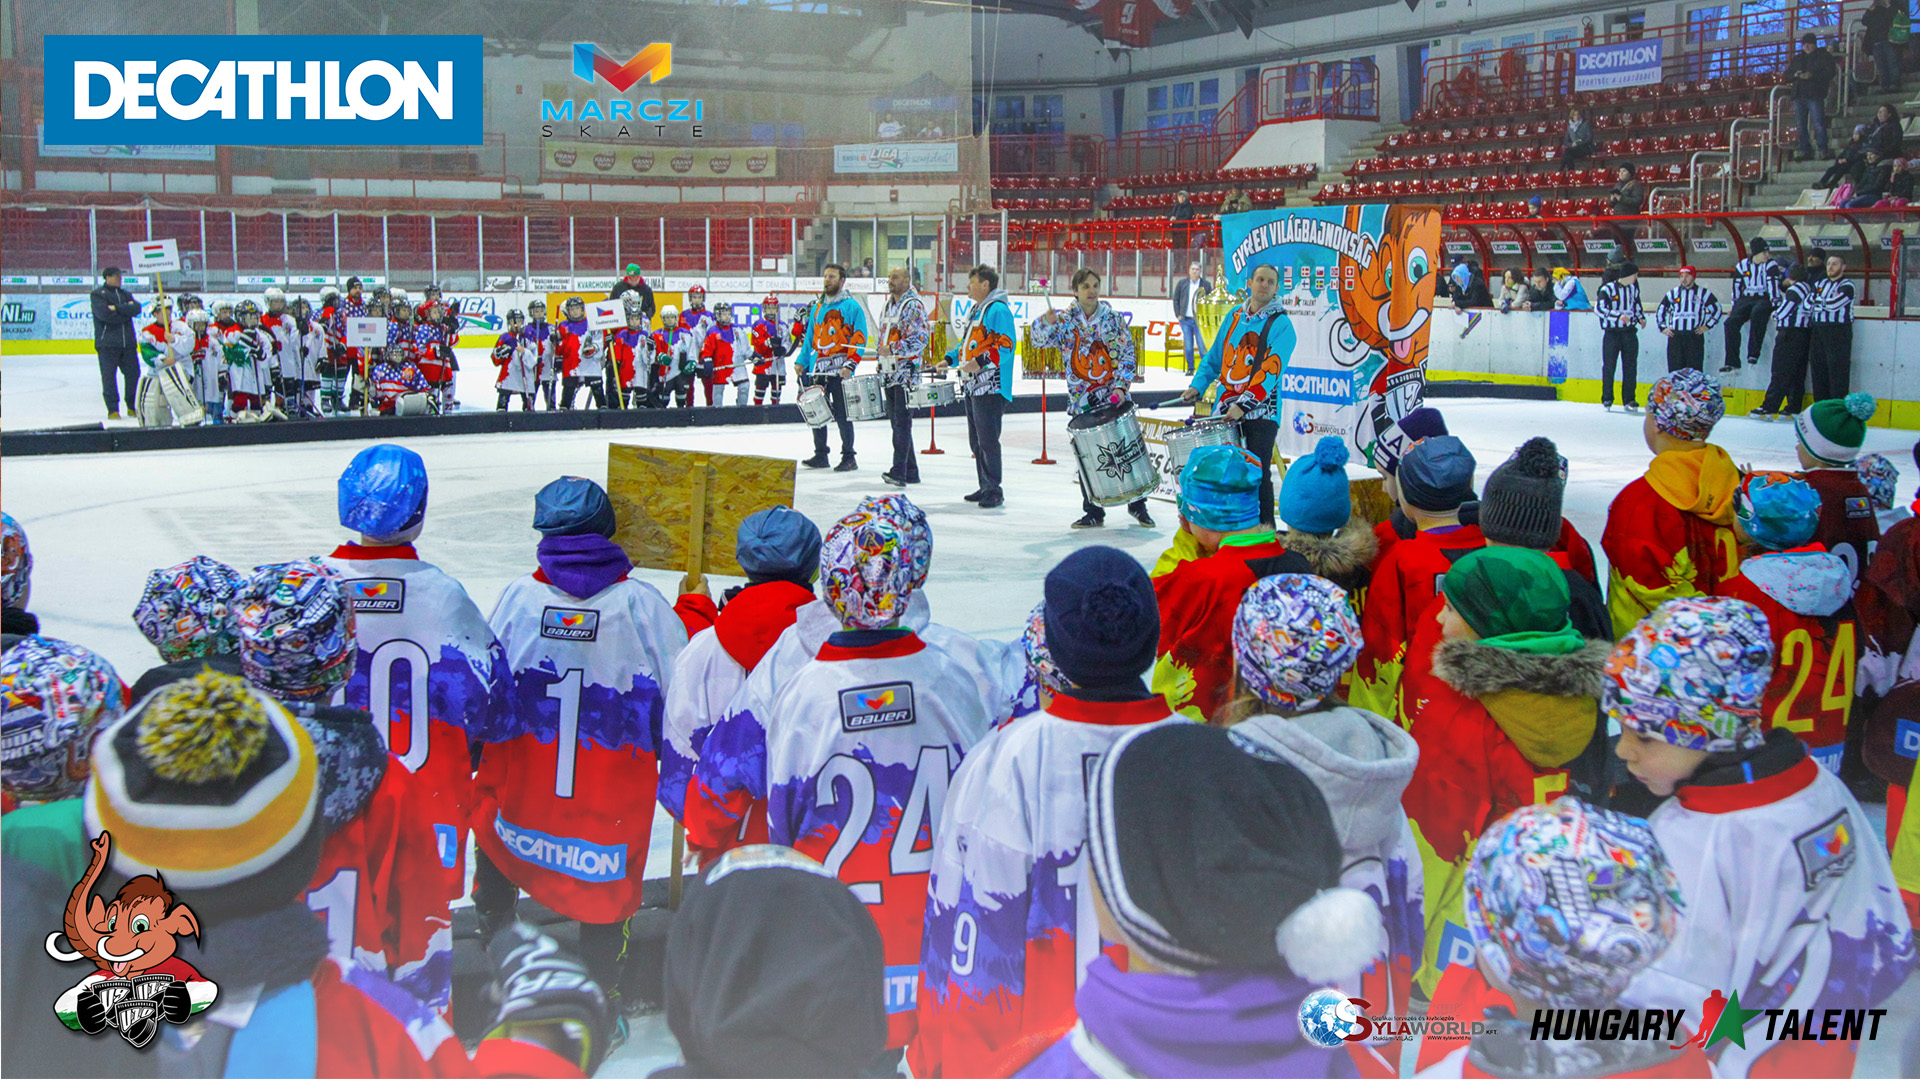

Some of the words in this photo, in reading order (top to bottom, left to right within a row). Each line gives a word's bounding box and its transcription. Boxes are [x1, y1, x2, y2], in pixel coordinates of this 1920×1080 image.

[1579, 45, 1657, 70] DECATHLON
[870, 148, 899, 159] LIGA
[1282, 373, 1351, 398] DECATHLON
[352, 599, 398, 609] AUER
[1771, 622, 1856, 733] 24
[545, 668, 585, 799] 1
[849, 709, 911, 728] BAUER
[816, 745, 951, 905] 24
[495, 822, 621, 877] DECATHLON
[951, 911, 978, 976] 9
